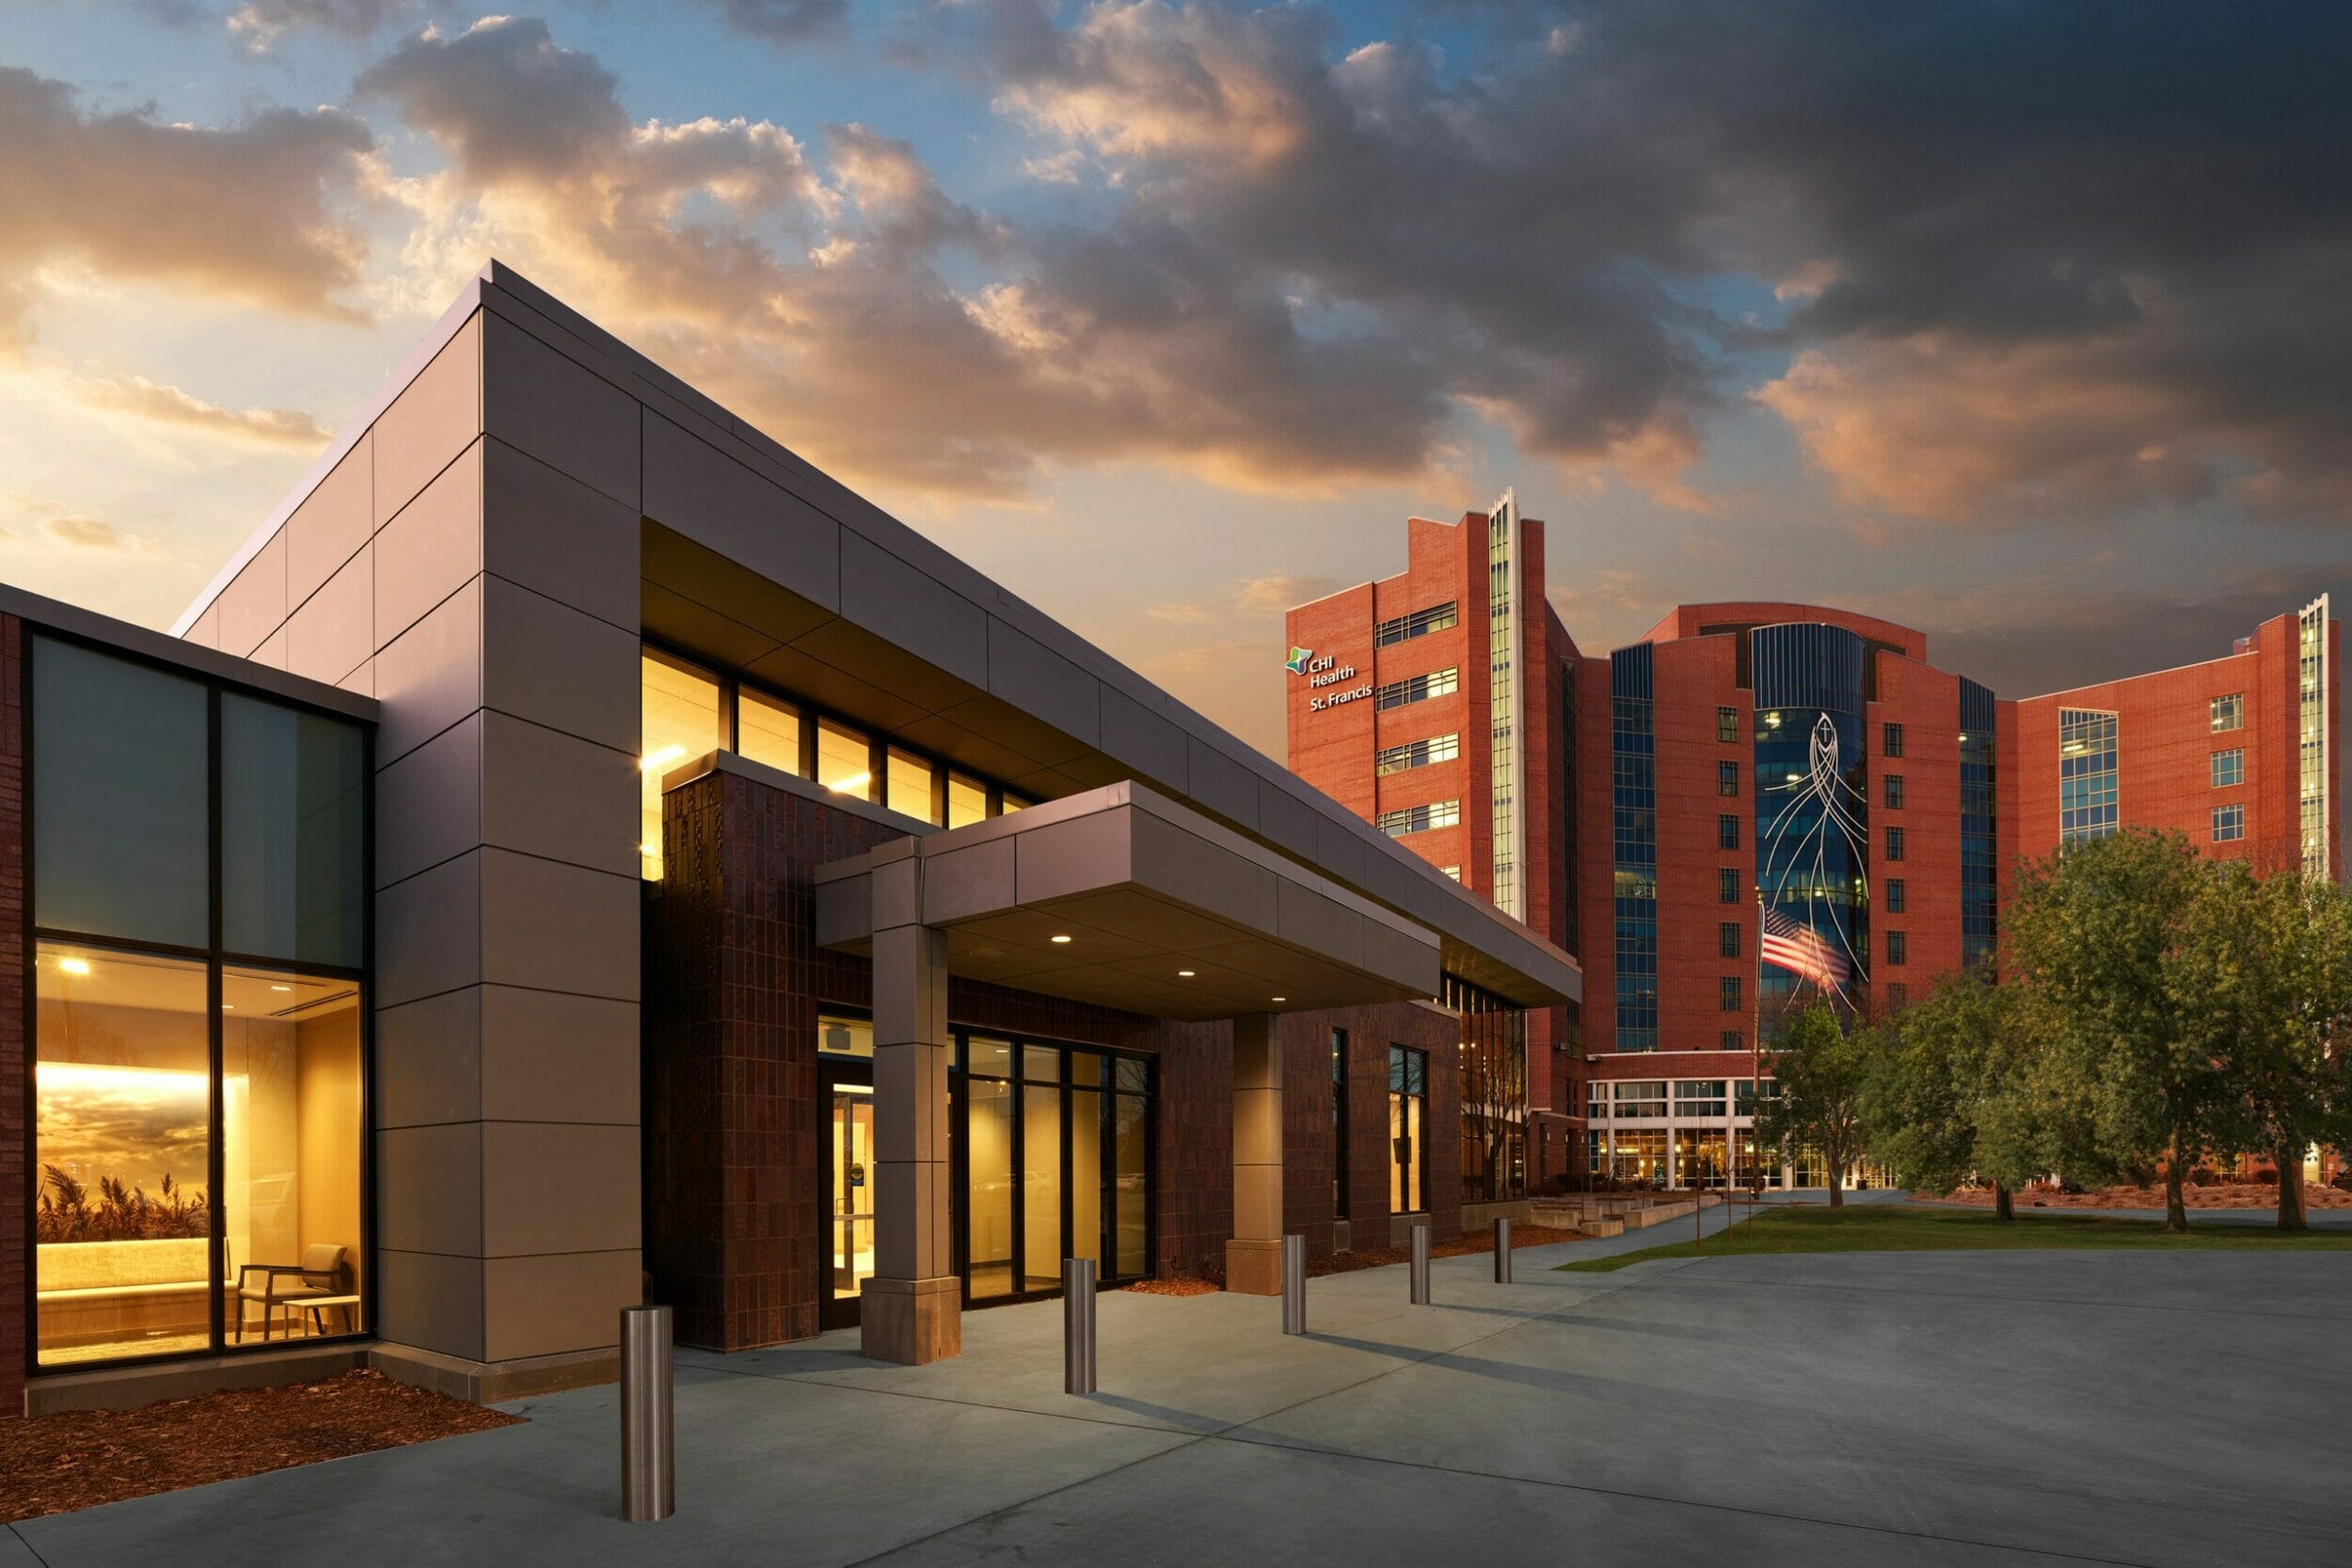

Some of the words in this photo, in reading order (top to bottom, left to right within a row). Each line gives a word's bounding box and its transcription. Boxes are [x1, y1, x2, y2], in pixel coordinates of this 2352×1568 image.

[1310, 656, 1333, 673] CHI
[1311, 665, 1354, 689] Health
[1311, 698, 1326, 712] St.
[1328, 684, 1373, 706] Francis
